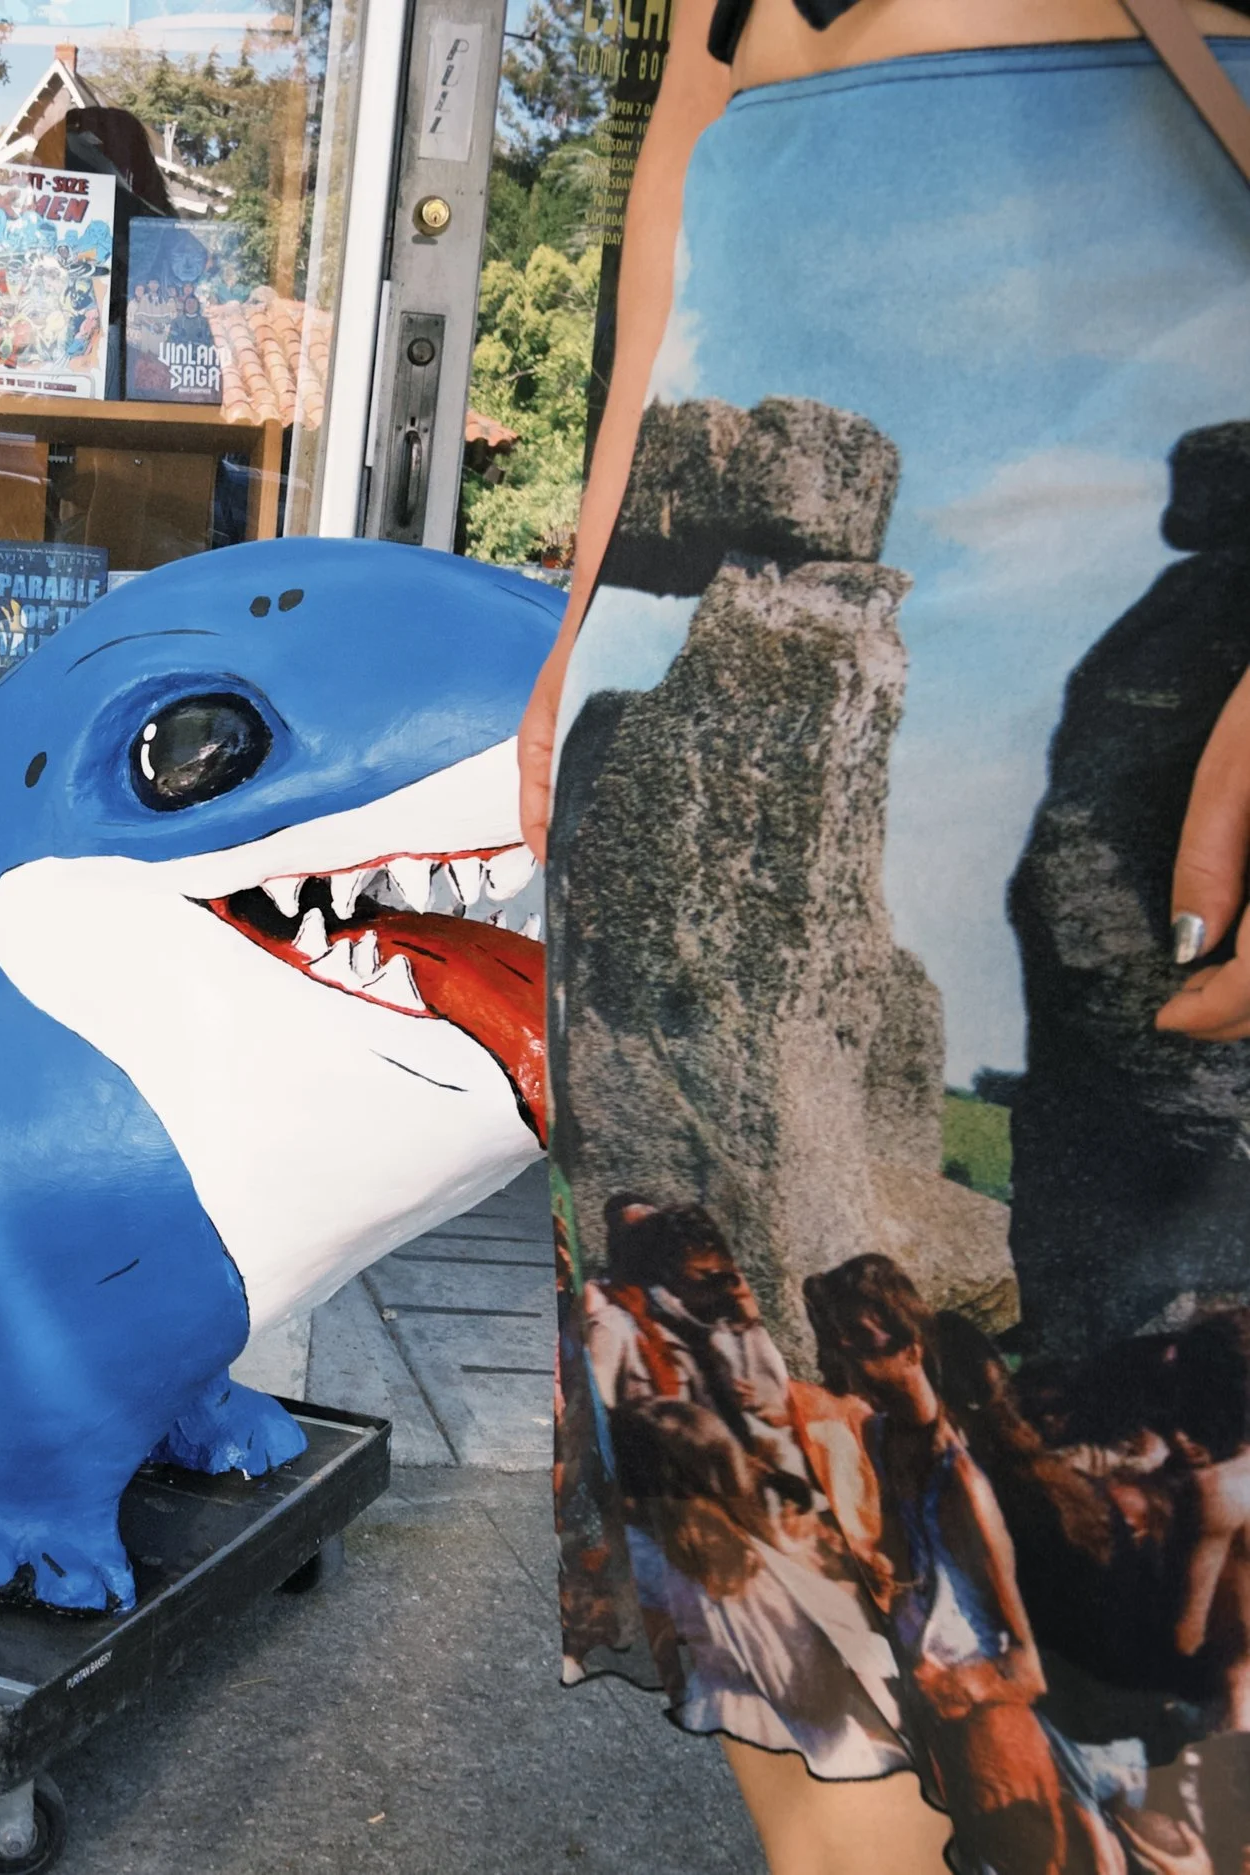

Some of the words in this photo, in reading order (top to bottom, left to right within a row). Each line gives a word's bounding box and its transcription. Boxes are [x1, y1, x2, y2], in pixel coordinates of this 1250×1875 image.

[429, 39, 470, 134] PULL
[610, 101, 634, 115] OPEN
[635, 103, 642, 116] 7
[598, 120, 636, 134] MONDAY
[595, 138, 633, 152] TUESDAY
[585, 211, 623, 226] SATURDA
[169, 364, 222, 392] SAGA
